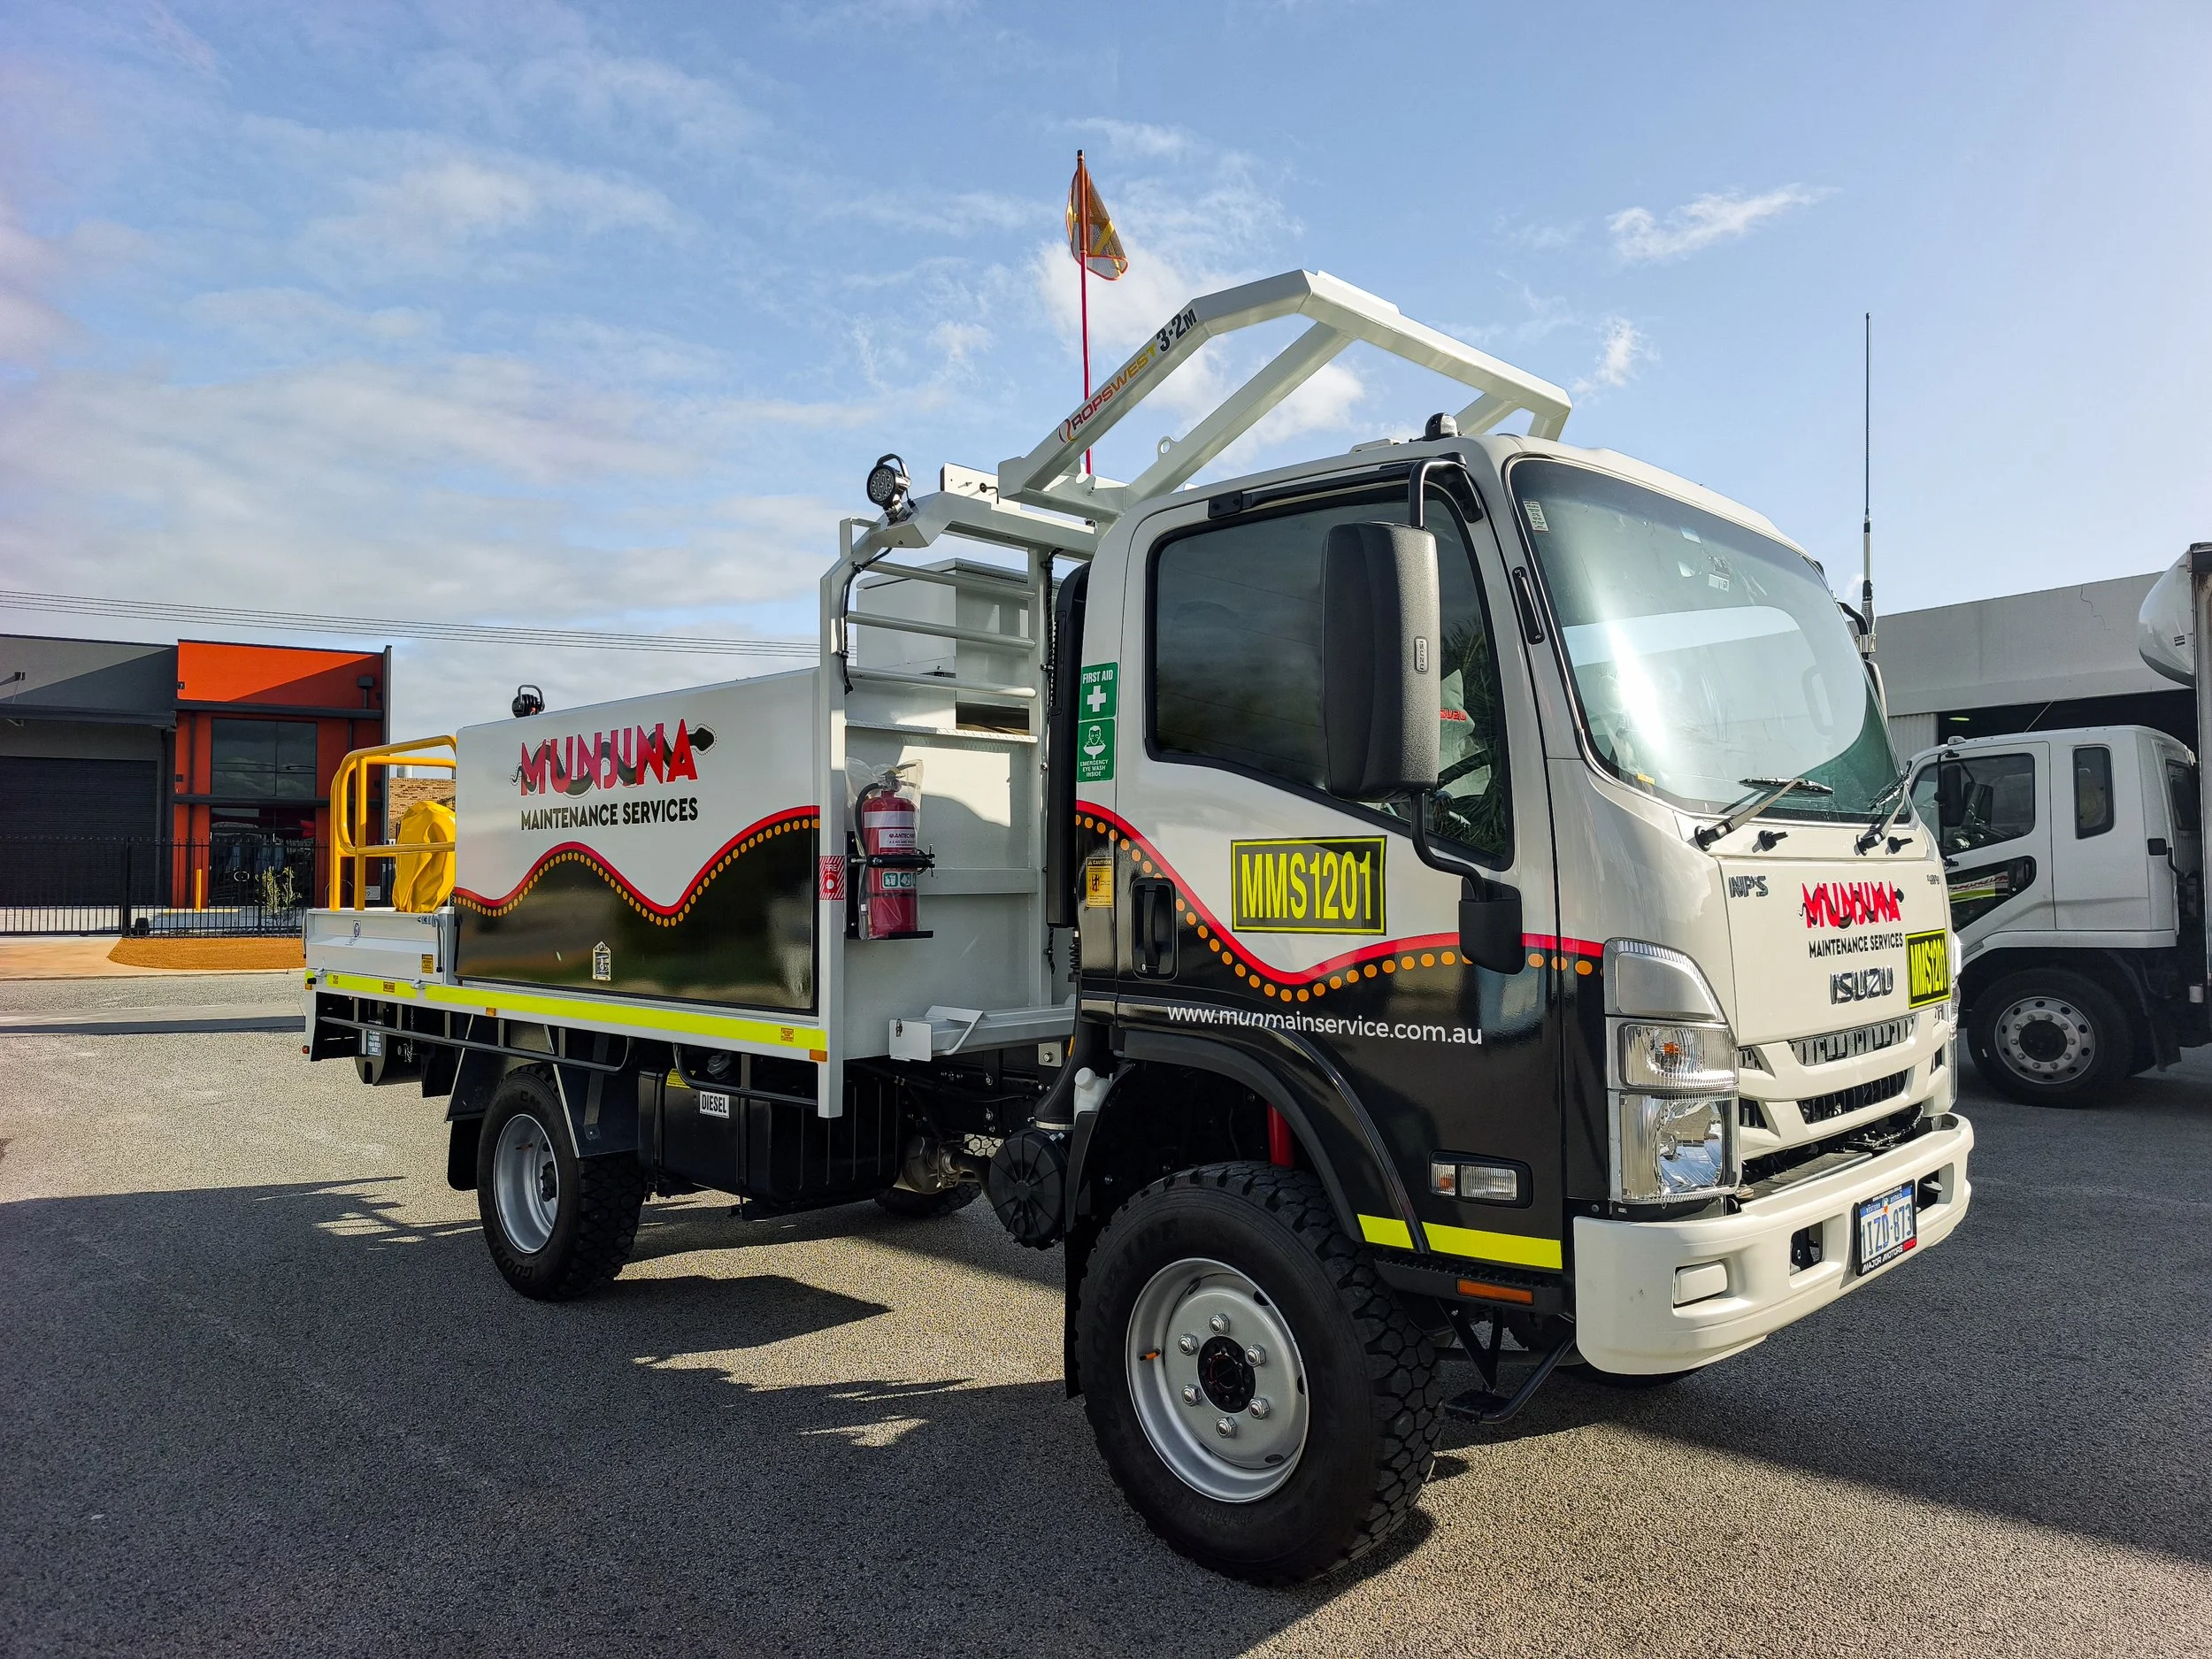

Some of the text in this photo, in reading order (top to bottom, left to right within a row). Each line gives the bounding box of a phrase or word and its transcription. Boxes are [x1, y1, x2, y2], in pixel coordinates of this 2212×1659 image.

[1071, 342, 1157, 431] ROPSWEST
[1082, 669, 1114, 684] FIRST AID
[1440, 709, 1467, 722] SUZU
[521, 796, 698, 831] MAINTENANCE SERVICES
[1241, 851, 1371, 920] MMS1201
[1728, 875, 1769, 898] NPS
[1809, 933, 1903, 958] MAINTENANCE SERVICES
[1910, 939, 1947, 997] MMS1201
[1830, 965, 1893, 1004] ISUZU
[1167, 1005, 1482, 1045] www.munmainservice.com.au
[702, 1094, 727, 1114] DIESEL
[1862, 1256, 1882, 1273] MAJOR
[1882, 1245, 1903, 1263] MOTORS
